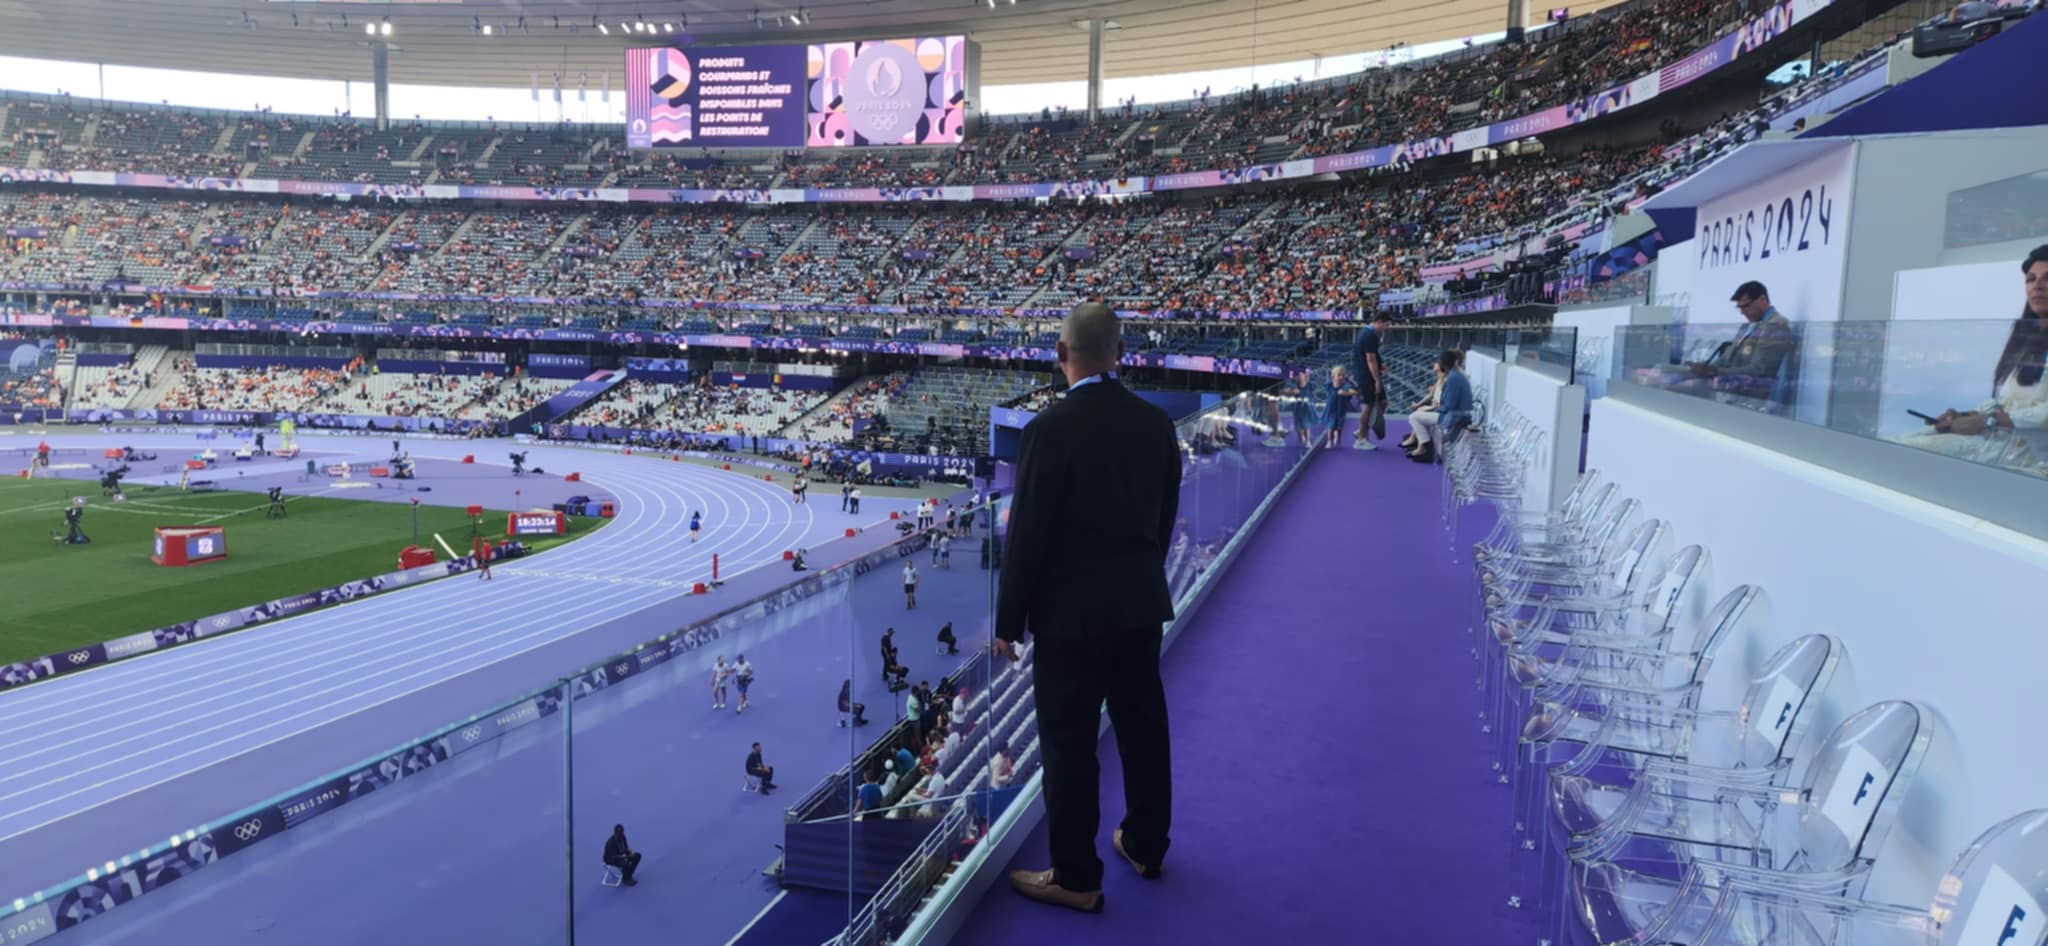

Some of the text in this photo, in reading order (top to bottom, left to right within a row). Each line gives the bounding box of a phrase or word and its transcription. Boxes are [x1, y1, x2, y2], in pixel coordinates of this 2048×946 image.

[699, 57, 745, 68] PRODUITS
[699, 70, 772, 82] GOURMANDS ET
[699, 85, 747, 96] BOISSONS
[699, 98, 784, 110] DISPONIBLES DANS
[699, 112, 764, 123] LES POINTS DE
[699, 126, 771, 136] RESTAURATION!
[1504, 116, 1550, 136] PARIS 2024
[1329, 154, 1375, 168] PARIS 2024
[1760, 184, 1832, 260] 2024
[203, 413, 233, 421] PARIS
[904, 455, 975, 467] PARIS 2024
[1775, 701, 1792, 730] F
[1853, 771, 1874, 806] F
[287, 789, 340, 816] PARIS 2024
[7, 916, 46, 941] 2024
[1997, 903, 2026, 946] F
